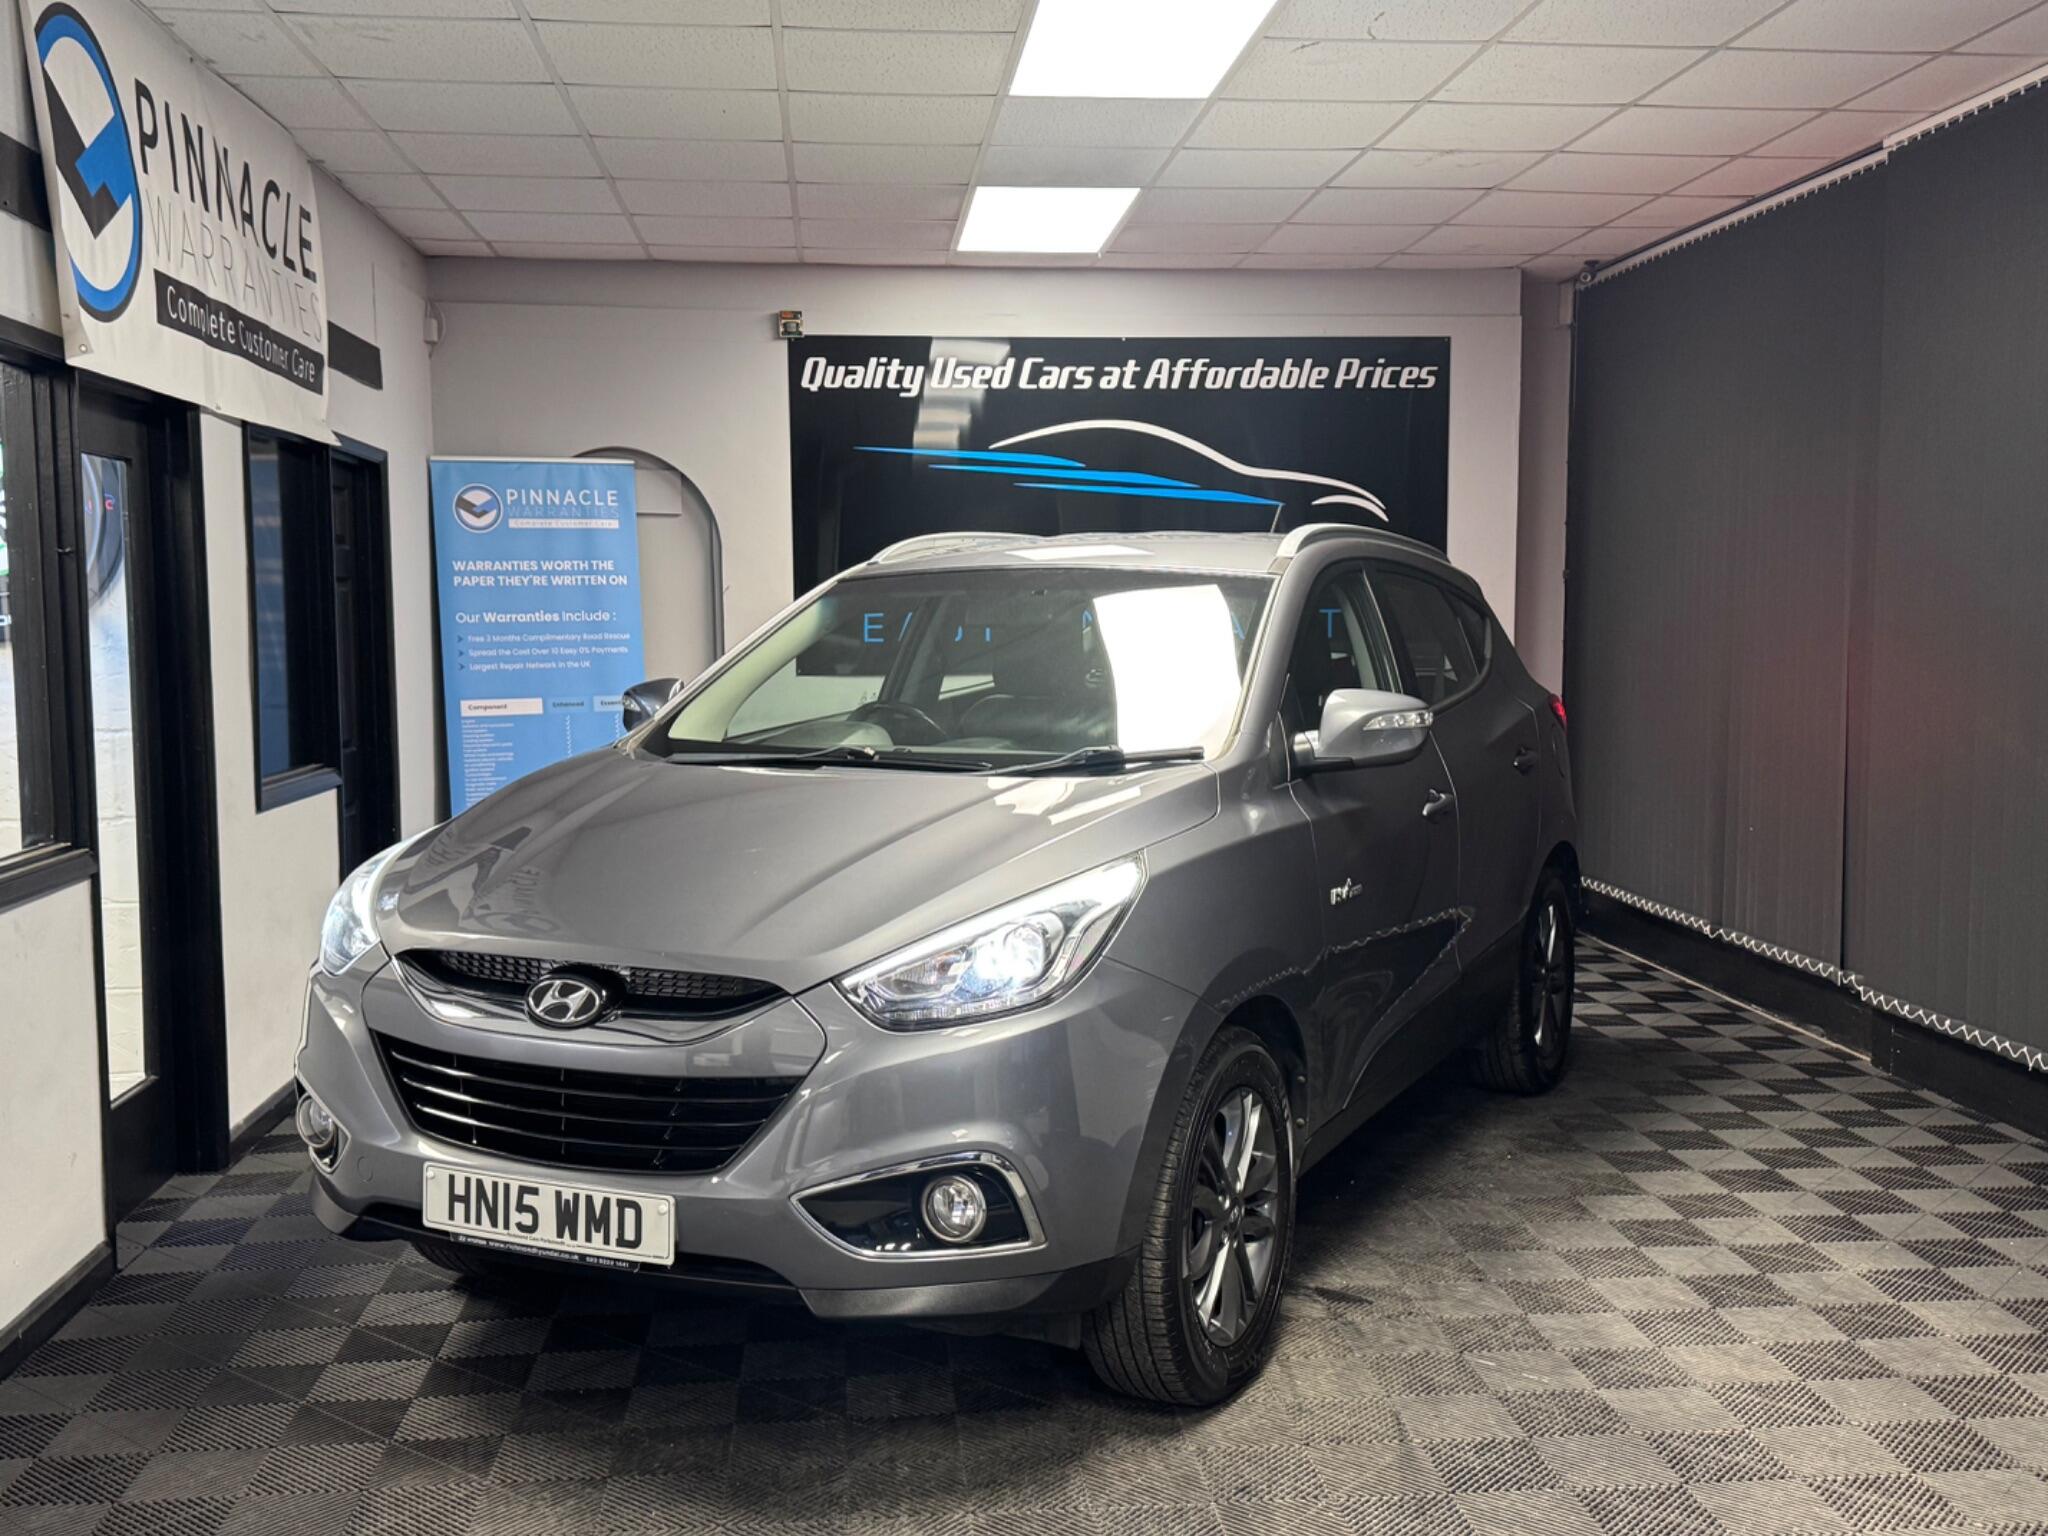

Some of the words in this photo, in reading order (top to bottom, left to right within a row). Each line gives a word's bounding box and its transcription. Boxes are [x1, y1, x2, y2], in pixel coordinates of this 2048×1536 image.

[134, 77, 318, 284] PINNACLE
[144, 189, 323, 344] WARRANTIES
[167, 285, 236, 344] Complete
[239, 320, 289, 372] Customer
[291, 347, 316, 382] Care
[801, 356, 925, 398] Quality
[930, 357, 1016, 390] Used
[1018, 357, 1095, 390] Cars
[1099, 359, 1140, 390] at
[1143, 358, 1330, 390] Affordable
[1334, 358, 1439, 389] Prices
[506, 489, 619, 506] PINNACLE
[453, 560, 538, 572] WARRANTIES
[540, 560, 589, 571] WORTH
[591, 560, 614, 570] THE
[453, 575, 495, 587] PAPER
[498, 575, 548, 586] THEY'RE
[551, 575, 606, 586] WRITTEN
[609, 575, 628, 586] ON
[455, 612, 480, 624] Our
[483, 610, 560, 624] Warranties
[562, 610, 610, 622] Include
[468, 635, 485, 643] Free
[493, 634, 520, 643] Months
[604, 632, 630, 641] Rescue
[469, 649, 496, 659] Spread
[498, 649, 511, 657] the
[512, 648, 530, 657] Cost
[532, 648, 549, 656] Over
[560, 647, 577, 657] Easy
[592, 646, 628, 656] Payments
[469, 662, 498, 673] Largest
[500, 662, 524, 672] Repair
[526, 661, 556, 670] Network
[567, 660, 580, 669] the
[581, 660, 591, 669] UK
[448, 1173, 540, 1234] HN15
[555, 1189, 643, 1249] WMD
